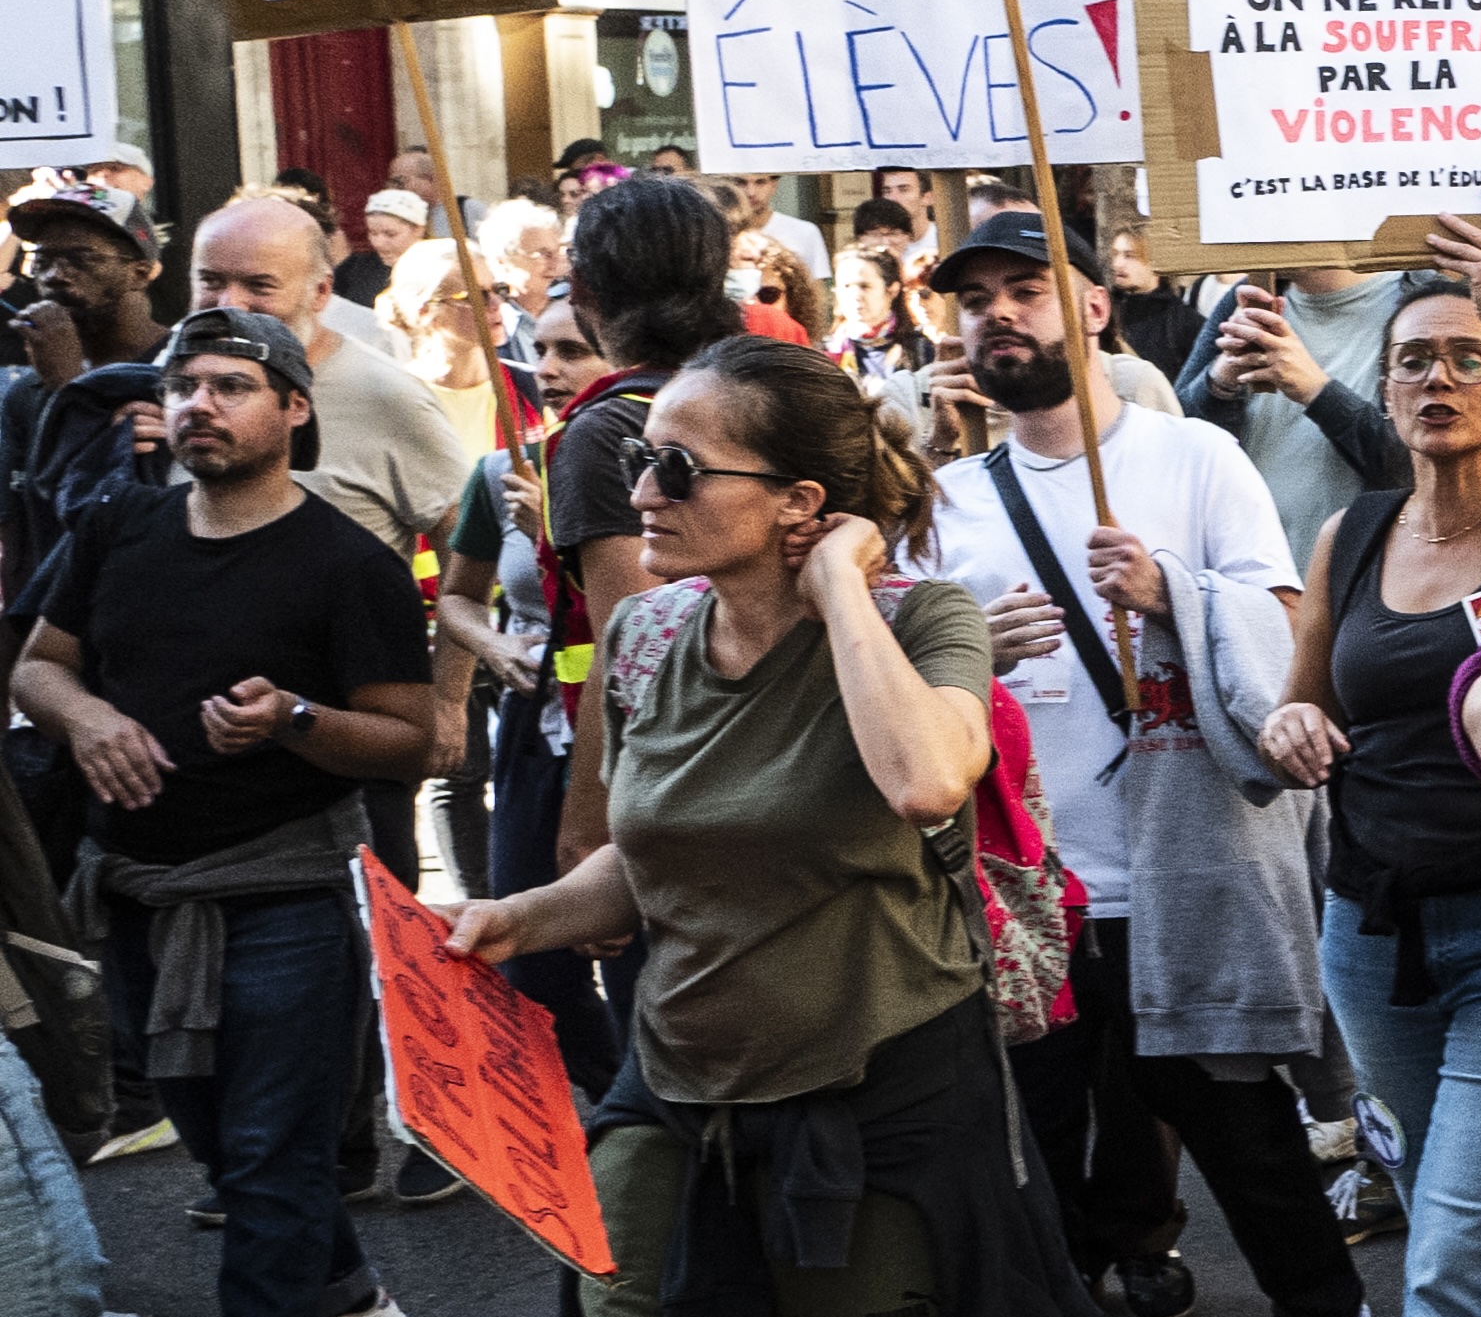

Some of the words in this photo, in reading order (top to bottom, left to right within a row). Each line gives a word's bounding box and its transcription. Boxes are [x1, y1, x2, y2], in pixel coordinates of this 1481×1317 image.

[1220, 15, 1245, 54] À
[1255, 21, 1303, 53] LA
[1318, 62, 1391, 93] PAR
[1411, 59, 1457, 90] LA
[1231, 178, 1291, 199] C'EST
[1301, 174, 1327, 192] LA
[1334, 170, 1387, 191] BASE
[1399, 170, 1420, 188] DE
